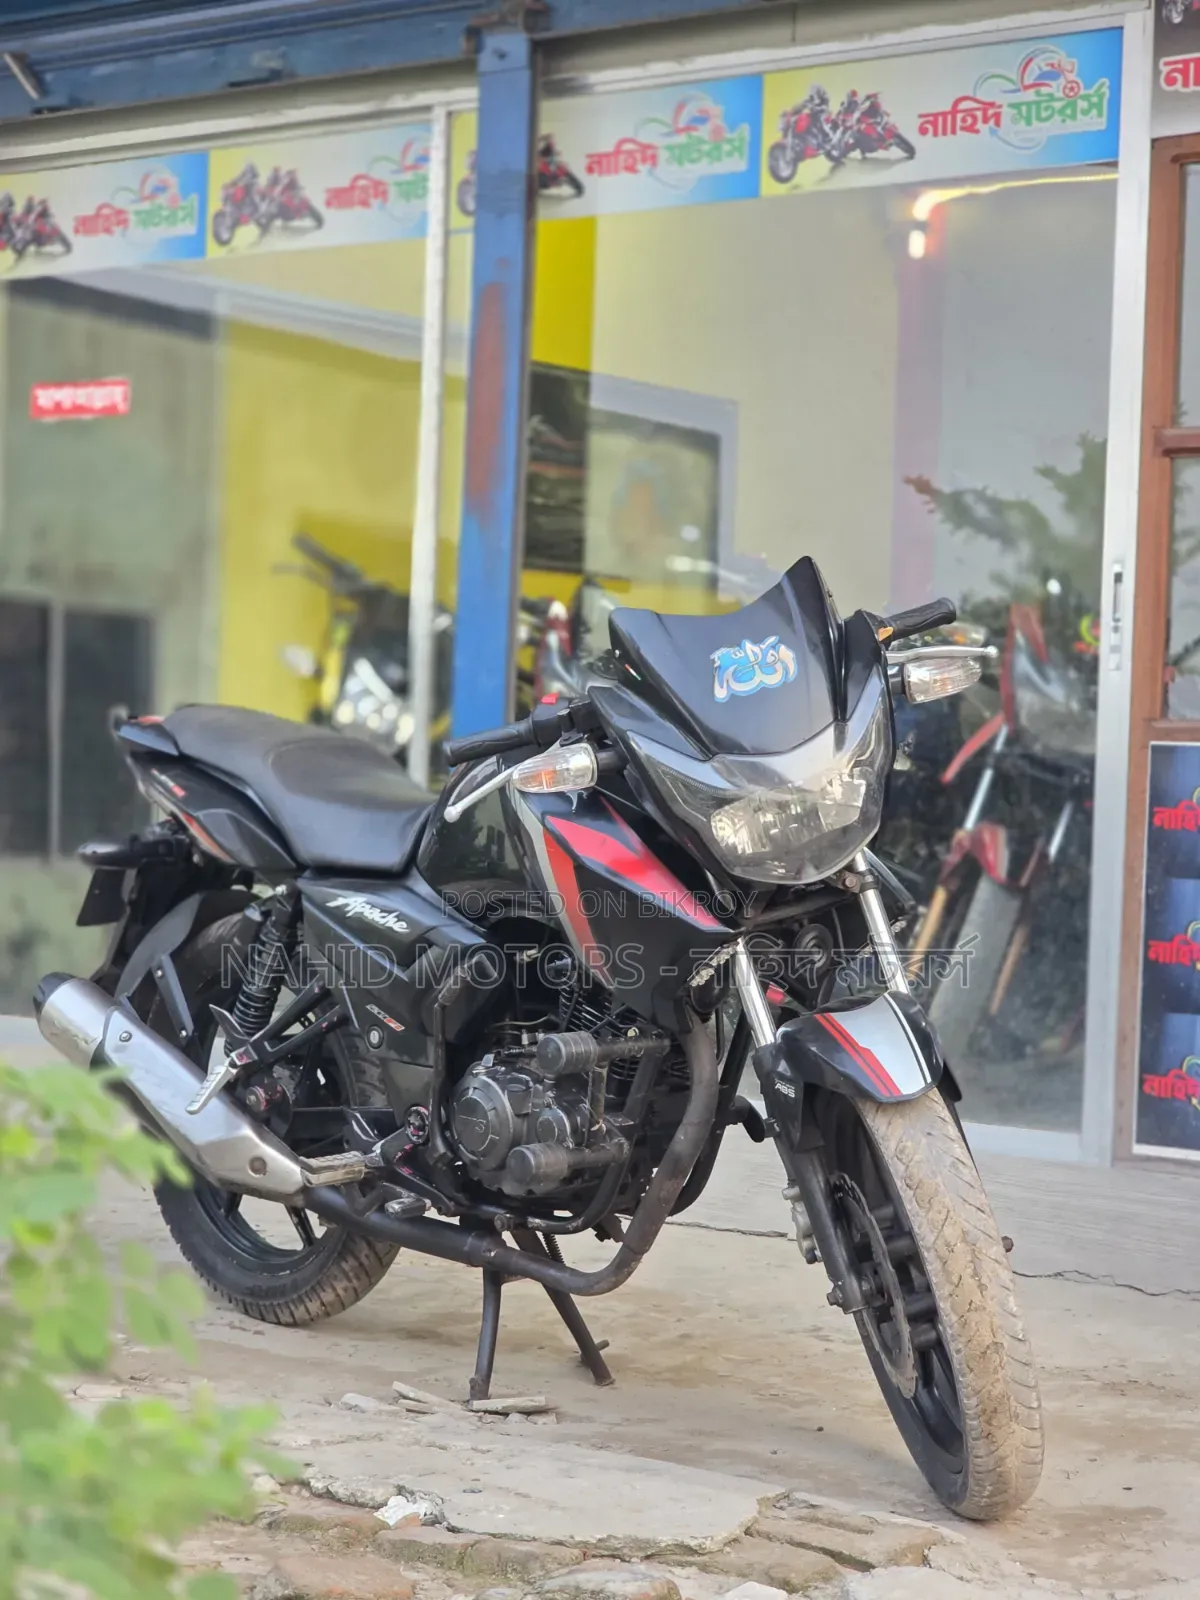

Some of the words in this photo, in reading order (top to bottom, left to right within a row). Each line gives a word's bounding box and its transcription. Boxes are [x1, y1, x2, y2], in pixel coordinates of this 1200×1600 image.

[917, 95, 1003, 138] নাহিদ
[585, 137, 659, 177] নাহিদ
[325, 896, 411, 935] Apache
[774, 1082, 796, 1099] ABS
